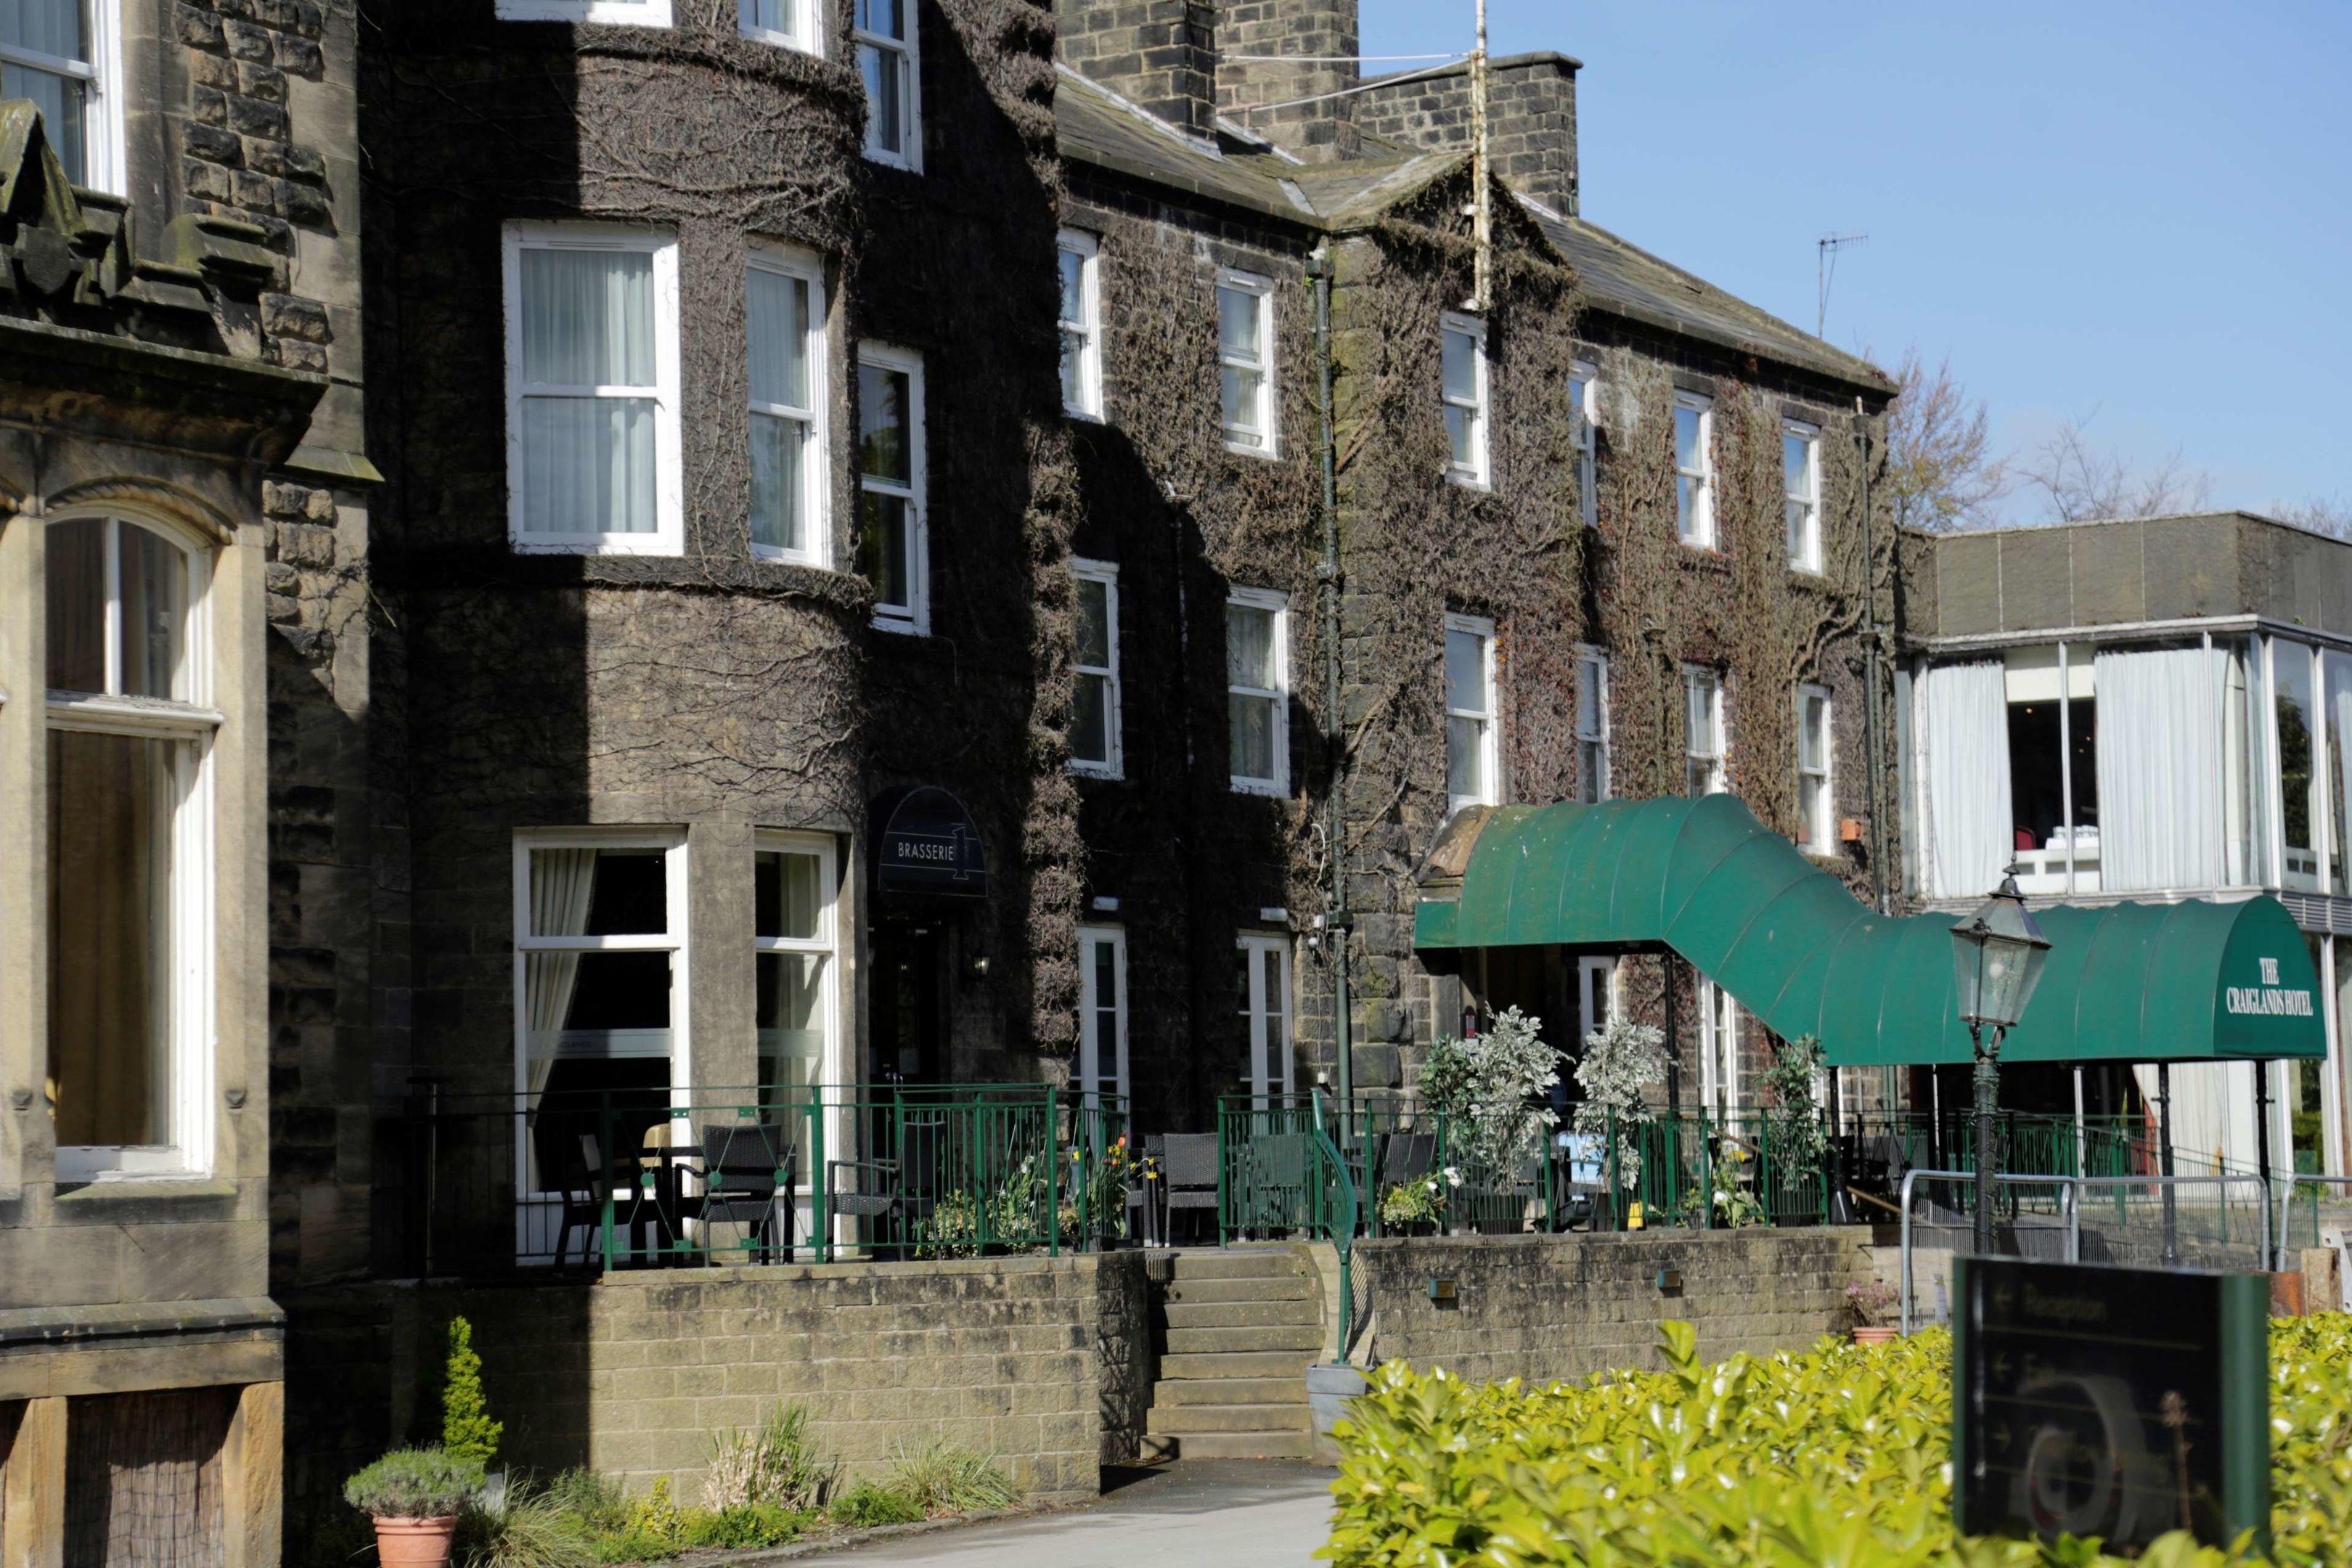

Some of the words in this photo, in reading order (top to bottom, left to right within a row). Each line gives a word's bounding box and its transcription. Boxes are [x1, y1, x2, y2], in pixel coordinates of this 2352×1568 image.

[898, 842, 954, 861] BRASSERIE
[2259, 957, 2279, 985] THE
[2226, 987, 2284, 1016] CRAIGLANDS
[2284, 989, 2314, 1016] HOTEL
